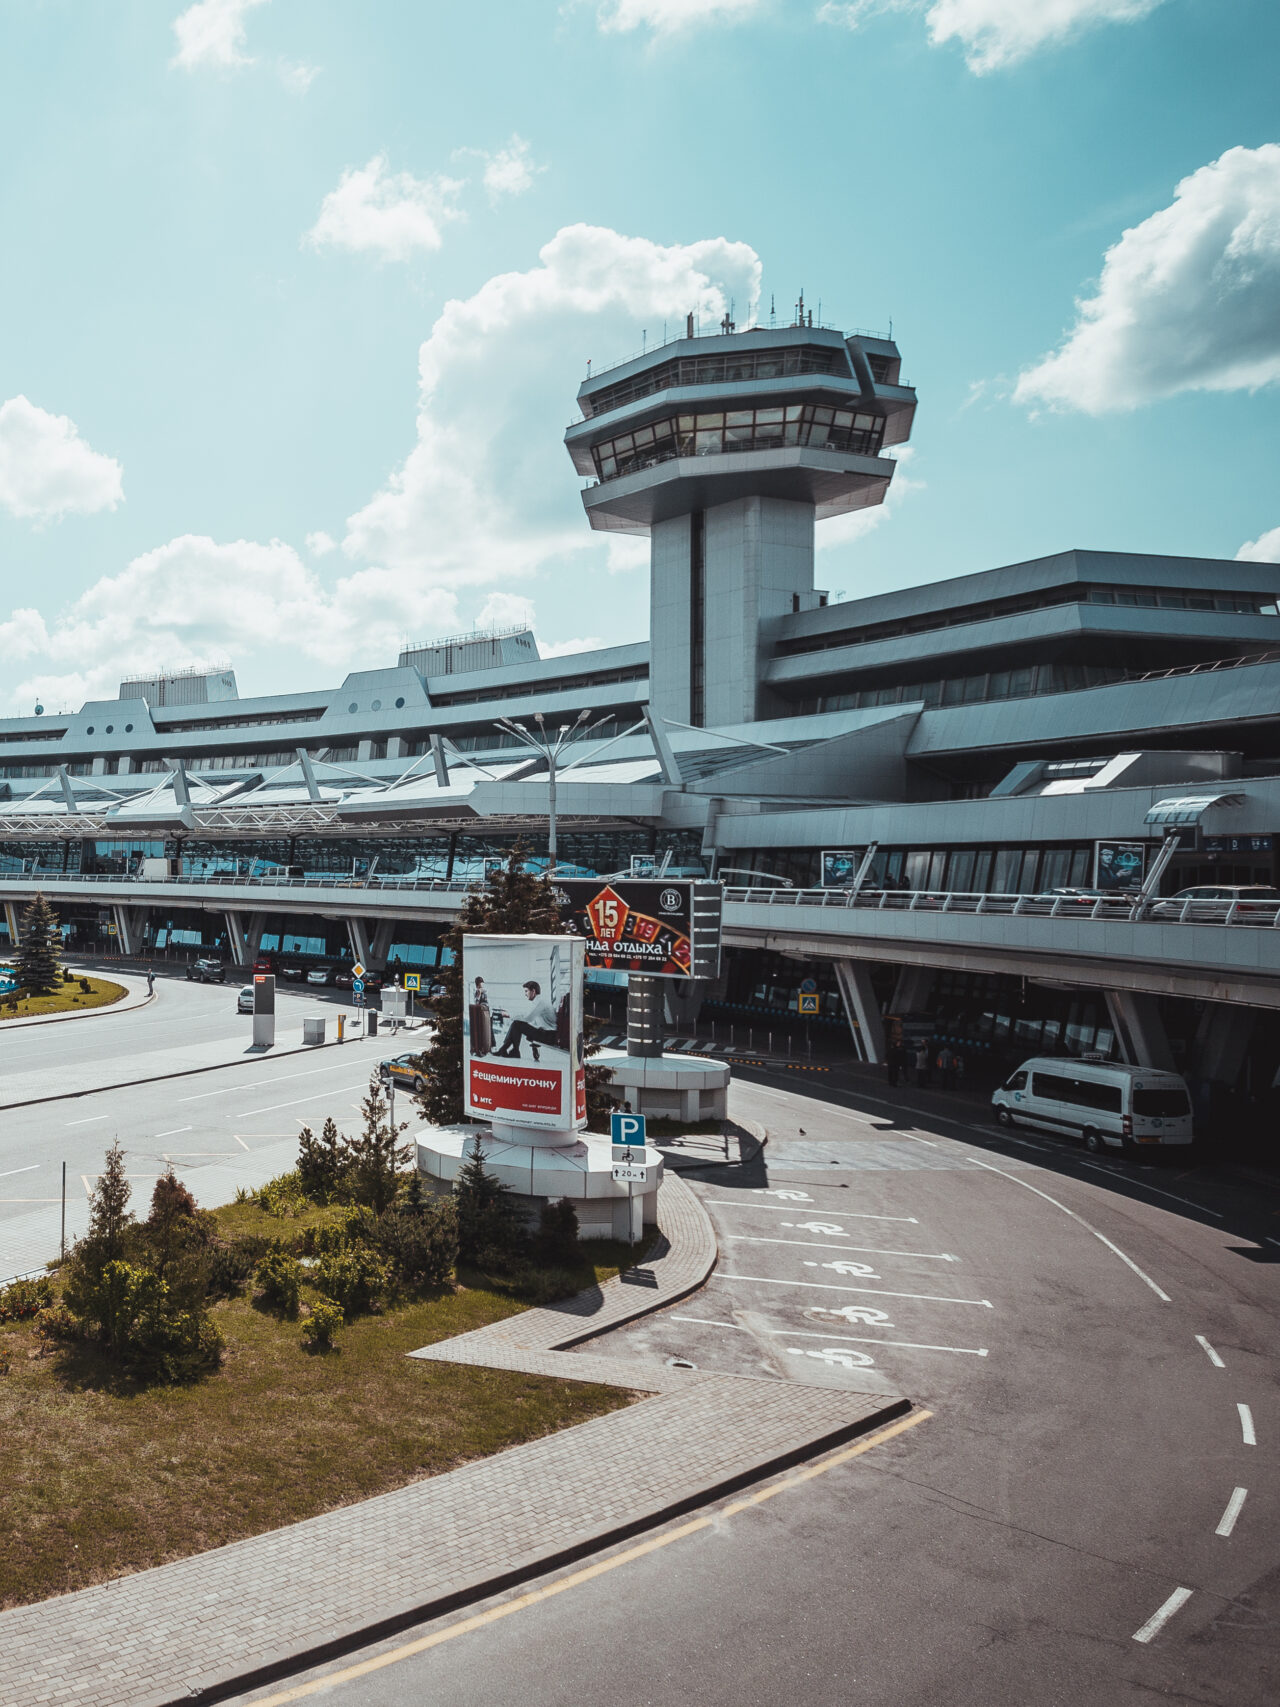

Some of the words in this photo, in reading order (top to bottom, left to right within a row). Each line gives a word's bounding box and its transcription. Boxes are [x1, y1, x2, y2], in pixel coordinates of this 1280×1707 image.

[594, 899, 619, 928] 15
[600, 928, 616, 938] ЛЕТ
[472, 1069, 557, 1090] #ещеминуточку
[620, 1117, 639, 1142] P
